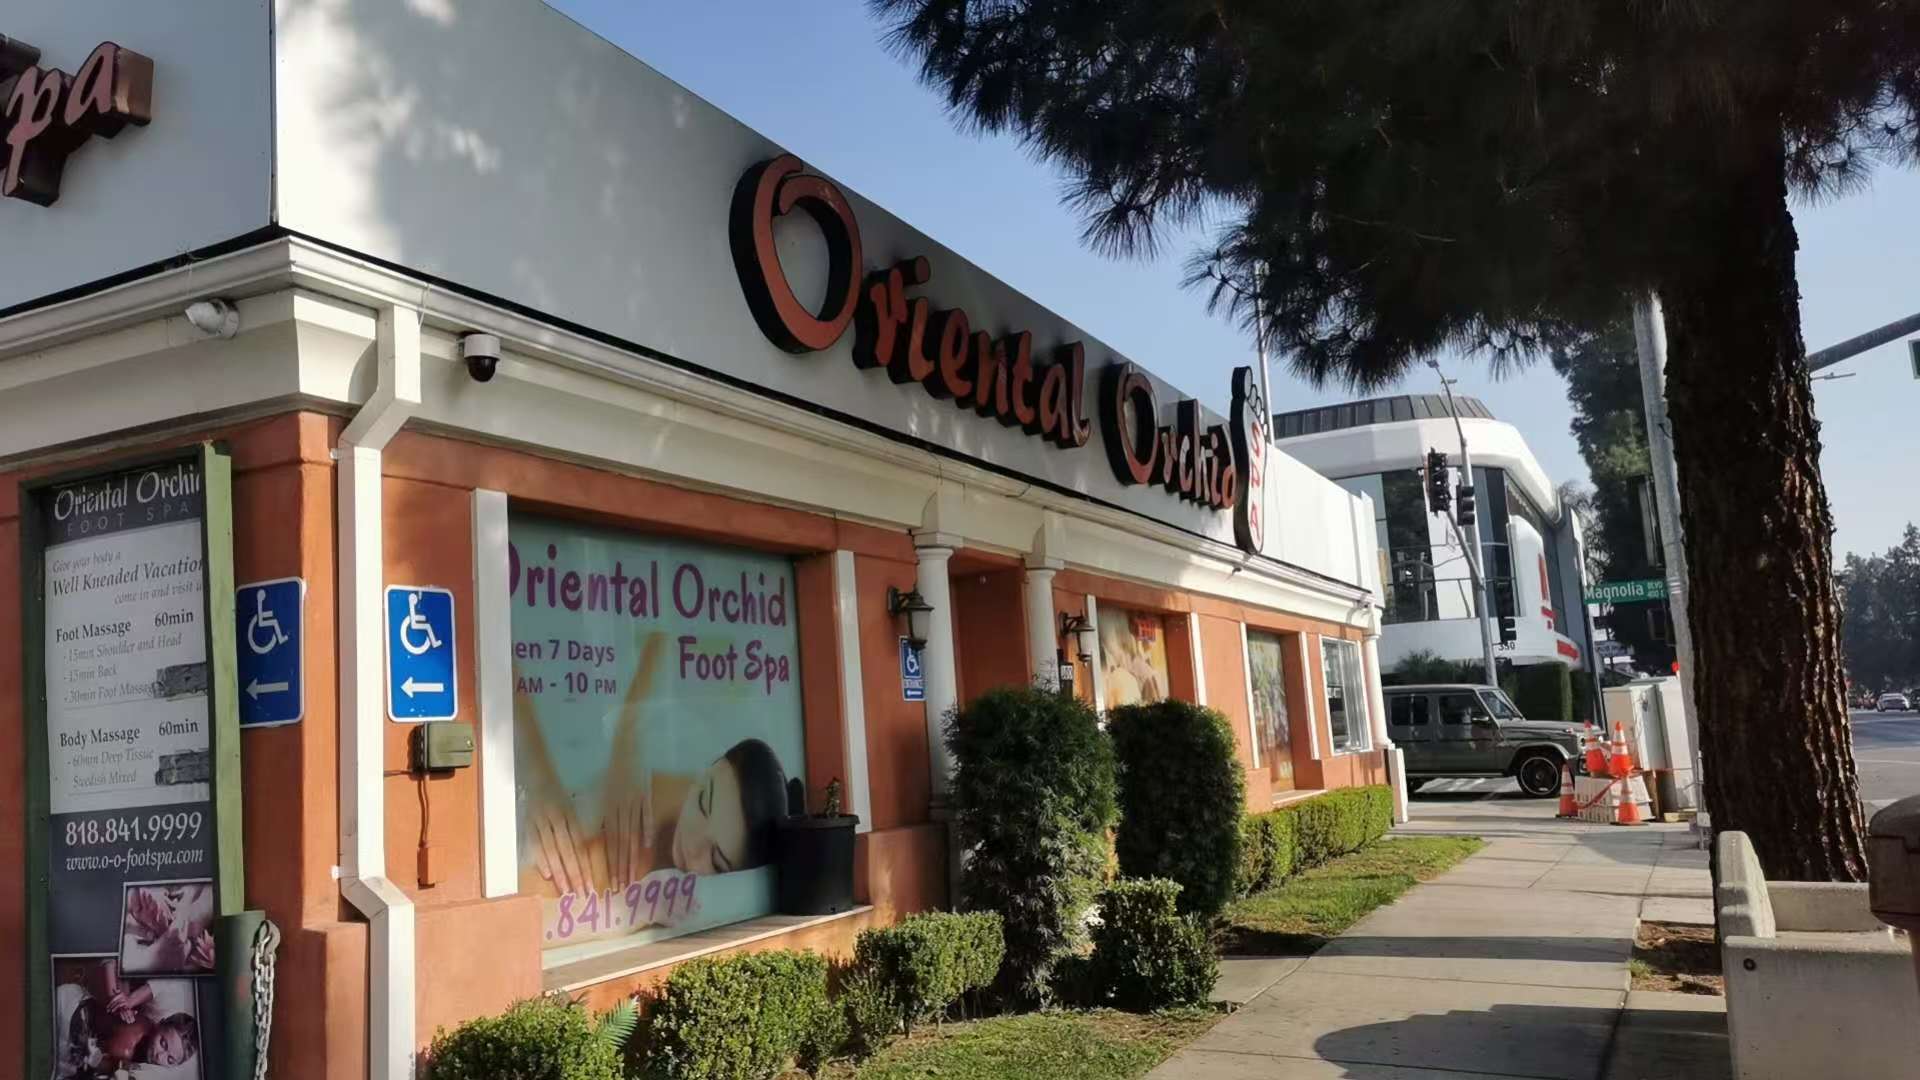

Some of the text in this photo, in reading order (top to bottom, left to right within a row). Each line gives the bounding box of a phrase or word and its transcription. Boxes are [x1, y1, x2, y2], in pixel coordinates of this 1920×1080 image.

[0, 41, 138, 203] pa
[729, 153, 1236, 509] Oriental Orchid
[54, 476, 128, 521] Oriental
[66, 501, 191, 537] FOOT SPA
[54, 575, 79, 597] Well
[83, 564, 139, 590] Kneaded
[672, 563, 788, 627] Orchid
[1584, 582, 1645, 602] Magnolia
[56, 609, 194, 643] Foot Massage 60min
[96, 640, 137, 658] Shoulder
[157, 633, 182, 648] Head
[511, 639, 615, 668] en 7 Days
[97, 664, 118, 677] Back
[678, 635, 790, 695] Foot Spa
[97, 683, 117, 699] Foot
[517, 676, 544, 694] AM
[564, 672, 588, 694] 10
[595, 678, 617, 694] PM
[60, 719, 199, 748] Body Massage 60min
[65, 812, 202, 845] 818.841.9999
[66, 848, 203, 874] www.o-o-footspa.com
